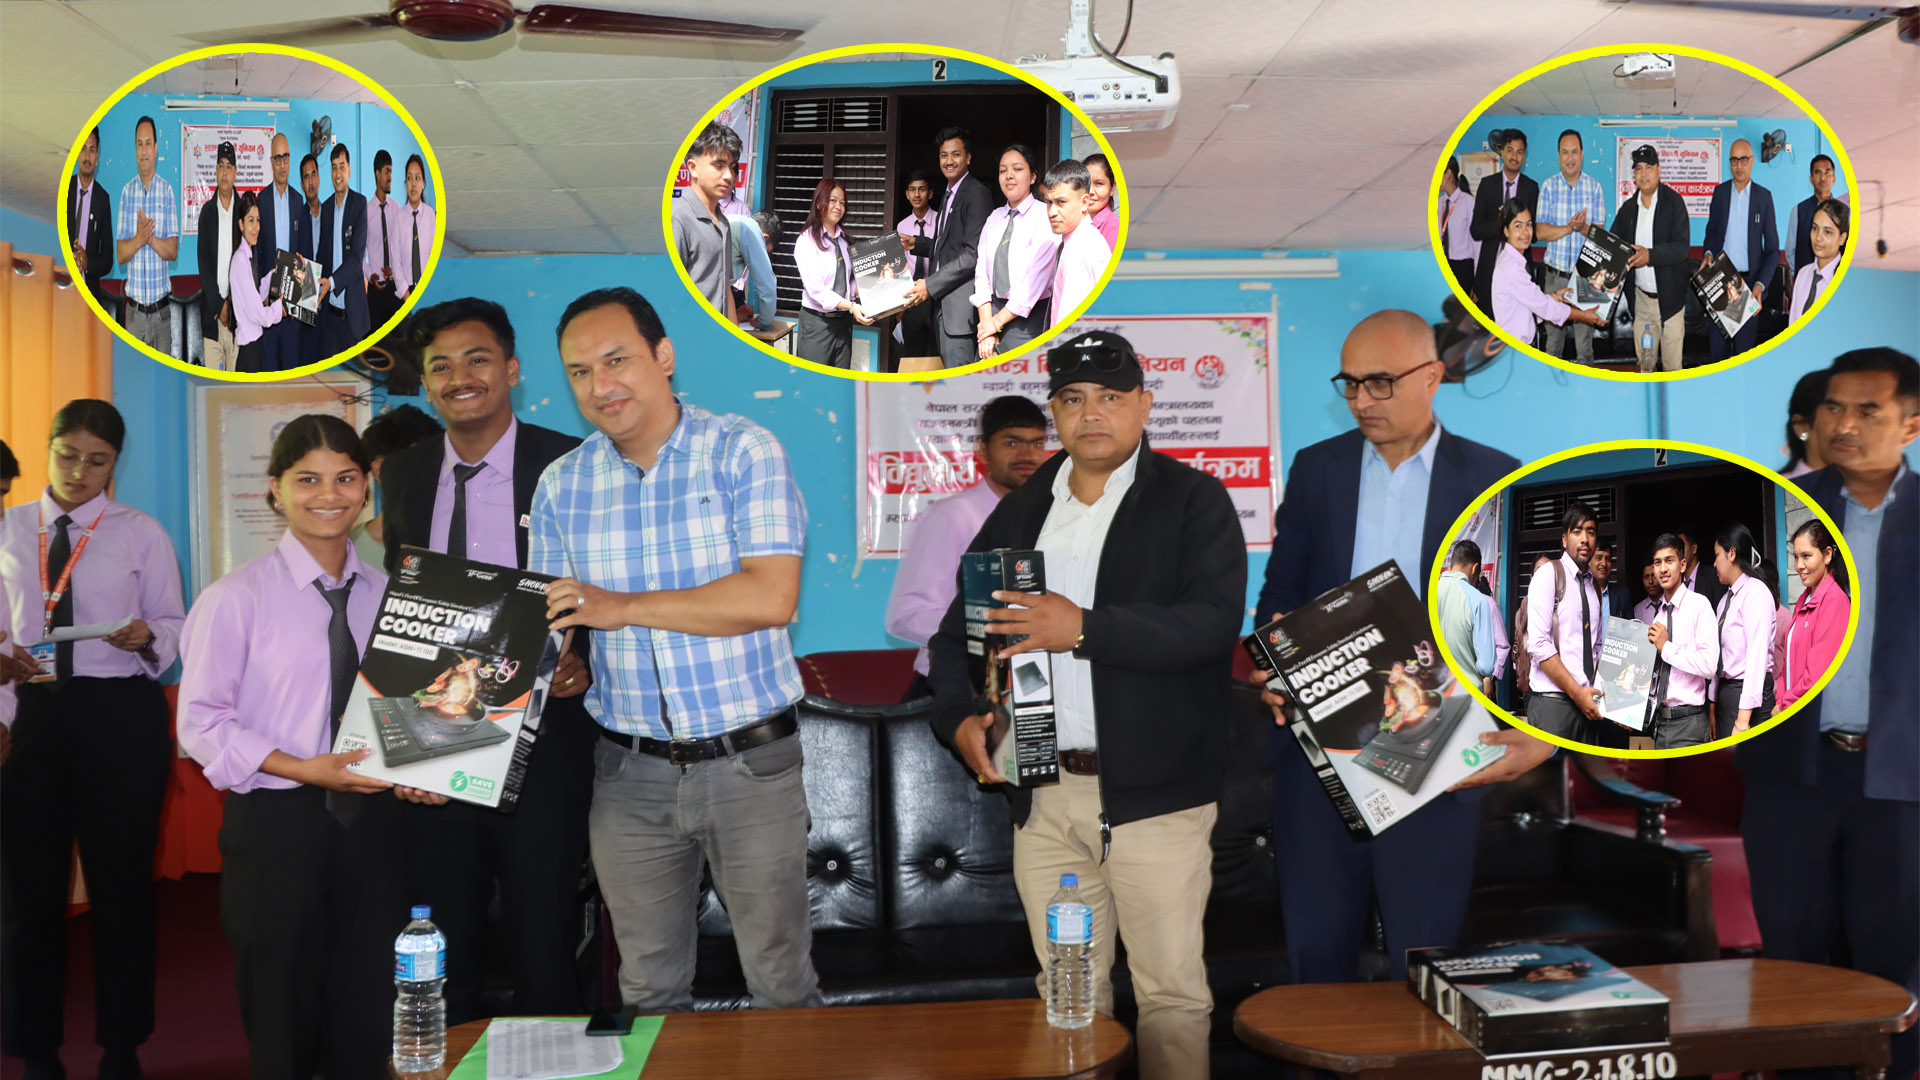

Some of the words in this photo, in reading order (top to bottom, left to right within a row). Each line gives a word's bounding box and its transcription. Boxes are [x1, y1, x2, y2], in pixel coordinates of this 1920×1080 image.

[935, 60, 945, 79] 2
[853, 251, 887, 267] INDUCTION
[854, 259, 880, 272] COOKER
[1656, 448, 1667, 466] 2
[519, 578, 549, 591] SHOVA
[384, 597, 492, 633] INDUCTION
[379, 615, 458, 645] COOKER
[1603, 646, 1628, 658] COOKER
[1604, 638, 1639, 653] INDUCTION
[1288, 628, 1385, 690] INDUCTION
[1299, 657, 1373, 704] COOKER
[472, 779, 493, 789] SAVE
[1433, 953, 1541, 967] INDUCTION
[1439, 961, 1520, 971] COOKER
